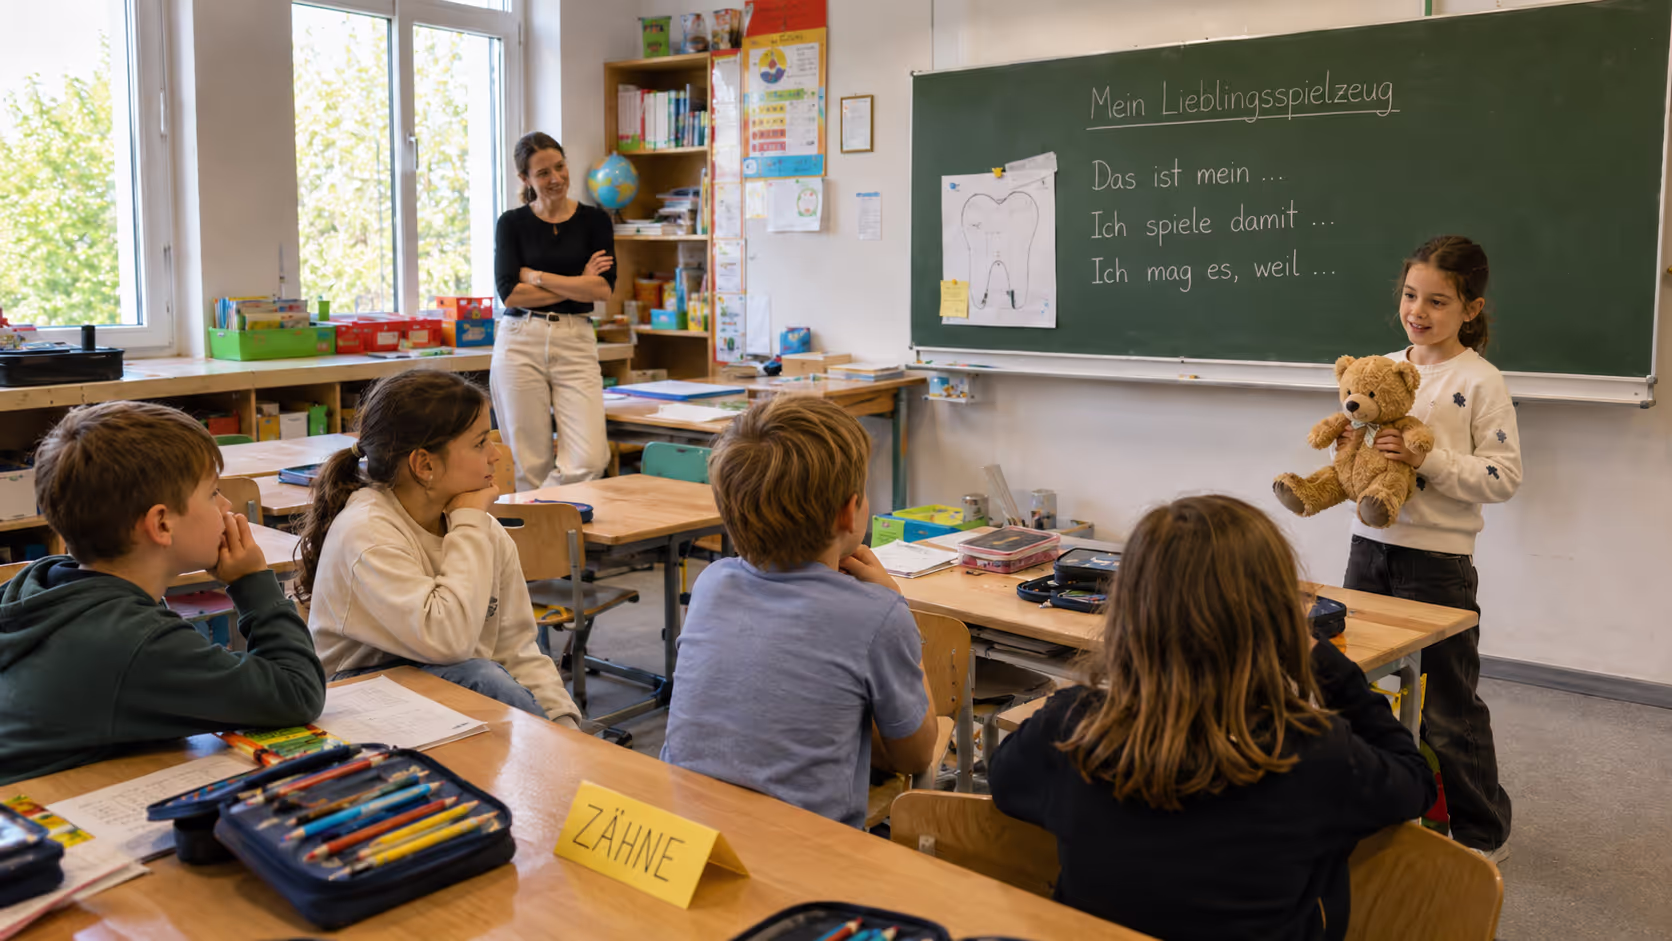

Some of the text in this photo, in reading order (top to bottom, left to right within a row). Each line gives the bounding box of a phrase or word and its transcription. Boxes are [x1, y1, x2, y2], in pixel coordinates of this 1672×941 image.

[1090, 70, 1393, 122] Mein Lieblingsspielzeug
[1091, 160, 1137, 190] Das
[1154, 158, 1182, 187] ist
[1197, 161, 1249, 185] mein
[1091, 210, 1127, 239] Ich
[1146, 206, 1213, 246] spiele
[1230, 200, 1298, 232] damit
[1091, 257, 1128, 284] Ich
[1147, 264, 1192, 292] mag
[1207, 263, 1239, 283] es,
[1254, 249, 1300, 277] weil
[572, 803, 685, 882] ZÄHNE
